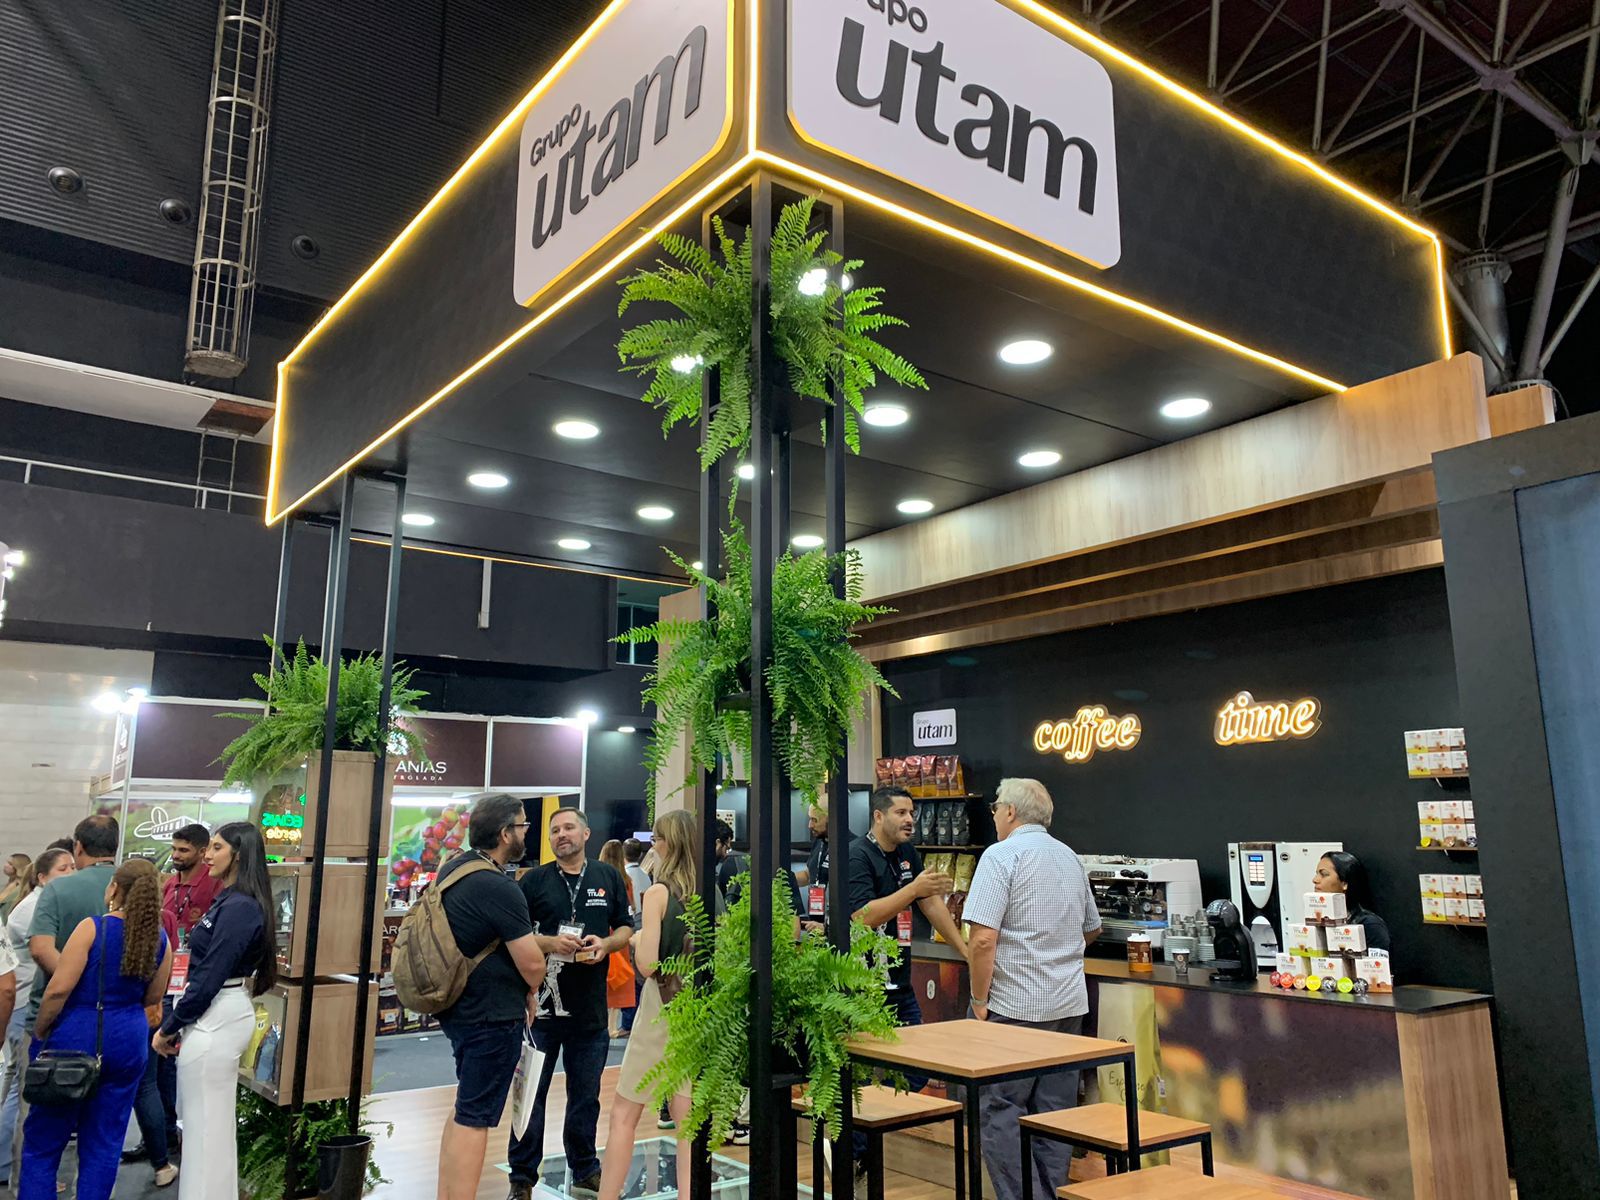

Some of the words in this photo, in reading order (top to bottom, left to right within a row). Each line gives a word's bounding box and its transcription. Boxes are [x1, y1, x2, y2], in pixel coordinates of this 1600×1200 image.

[530, 103, 581, 167] Grupo
[532, 25, 707, 249] utam
[836, 16, 1098, 216] utam
[918, 723, 953, 739] utam
[1034, 706, 1140, 760] coffee
[1218, 694, 1316, 742] time
